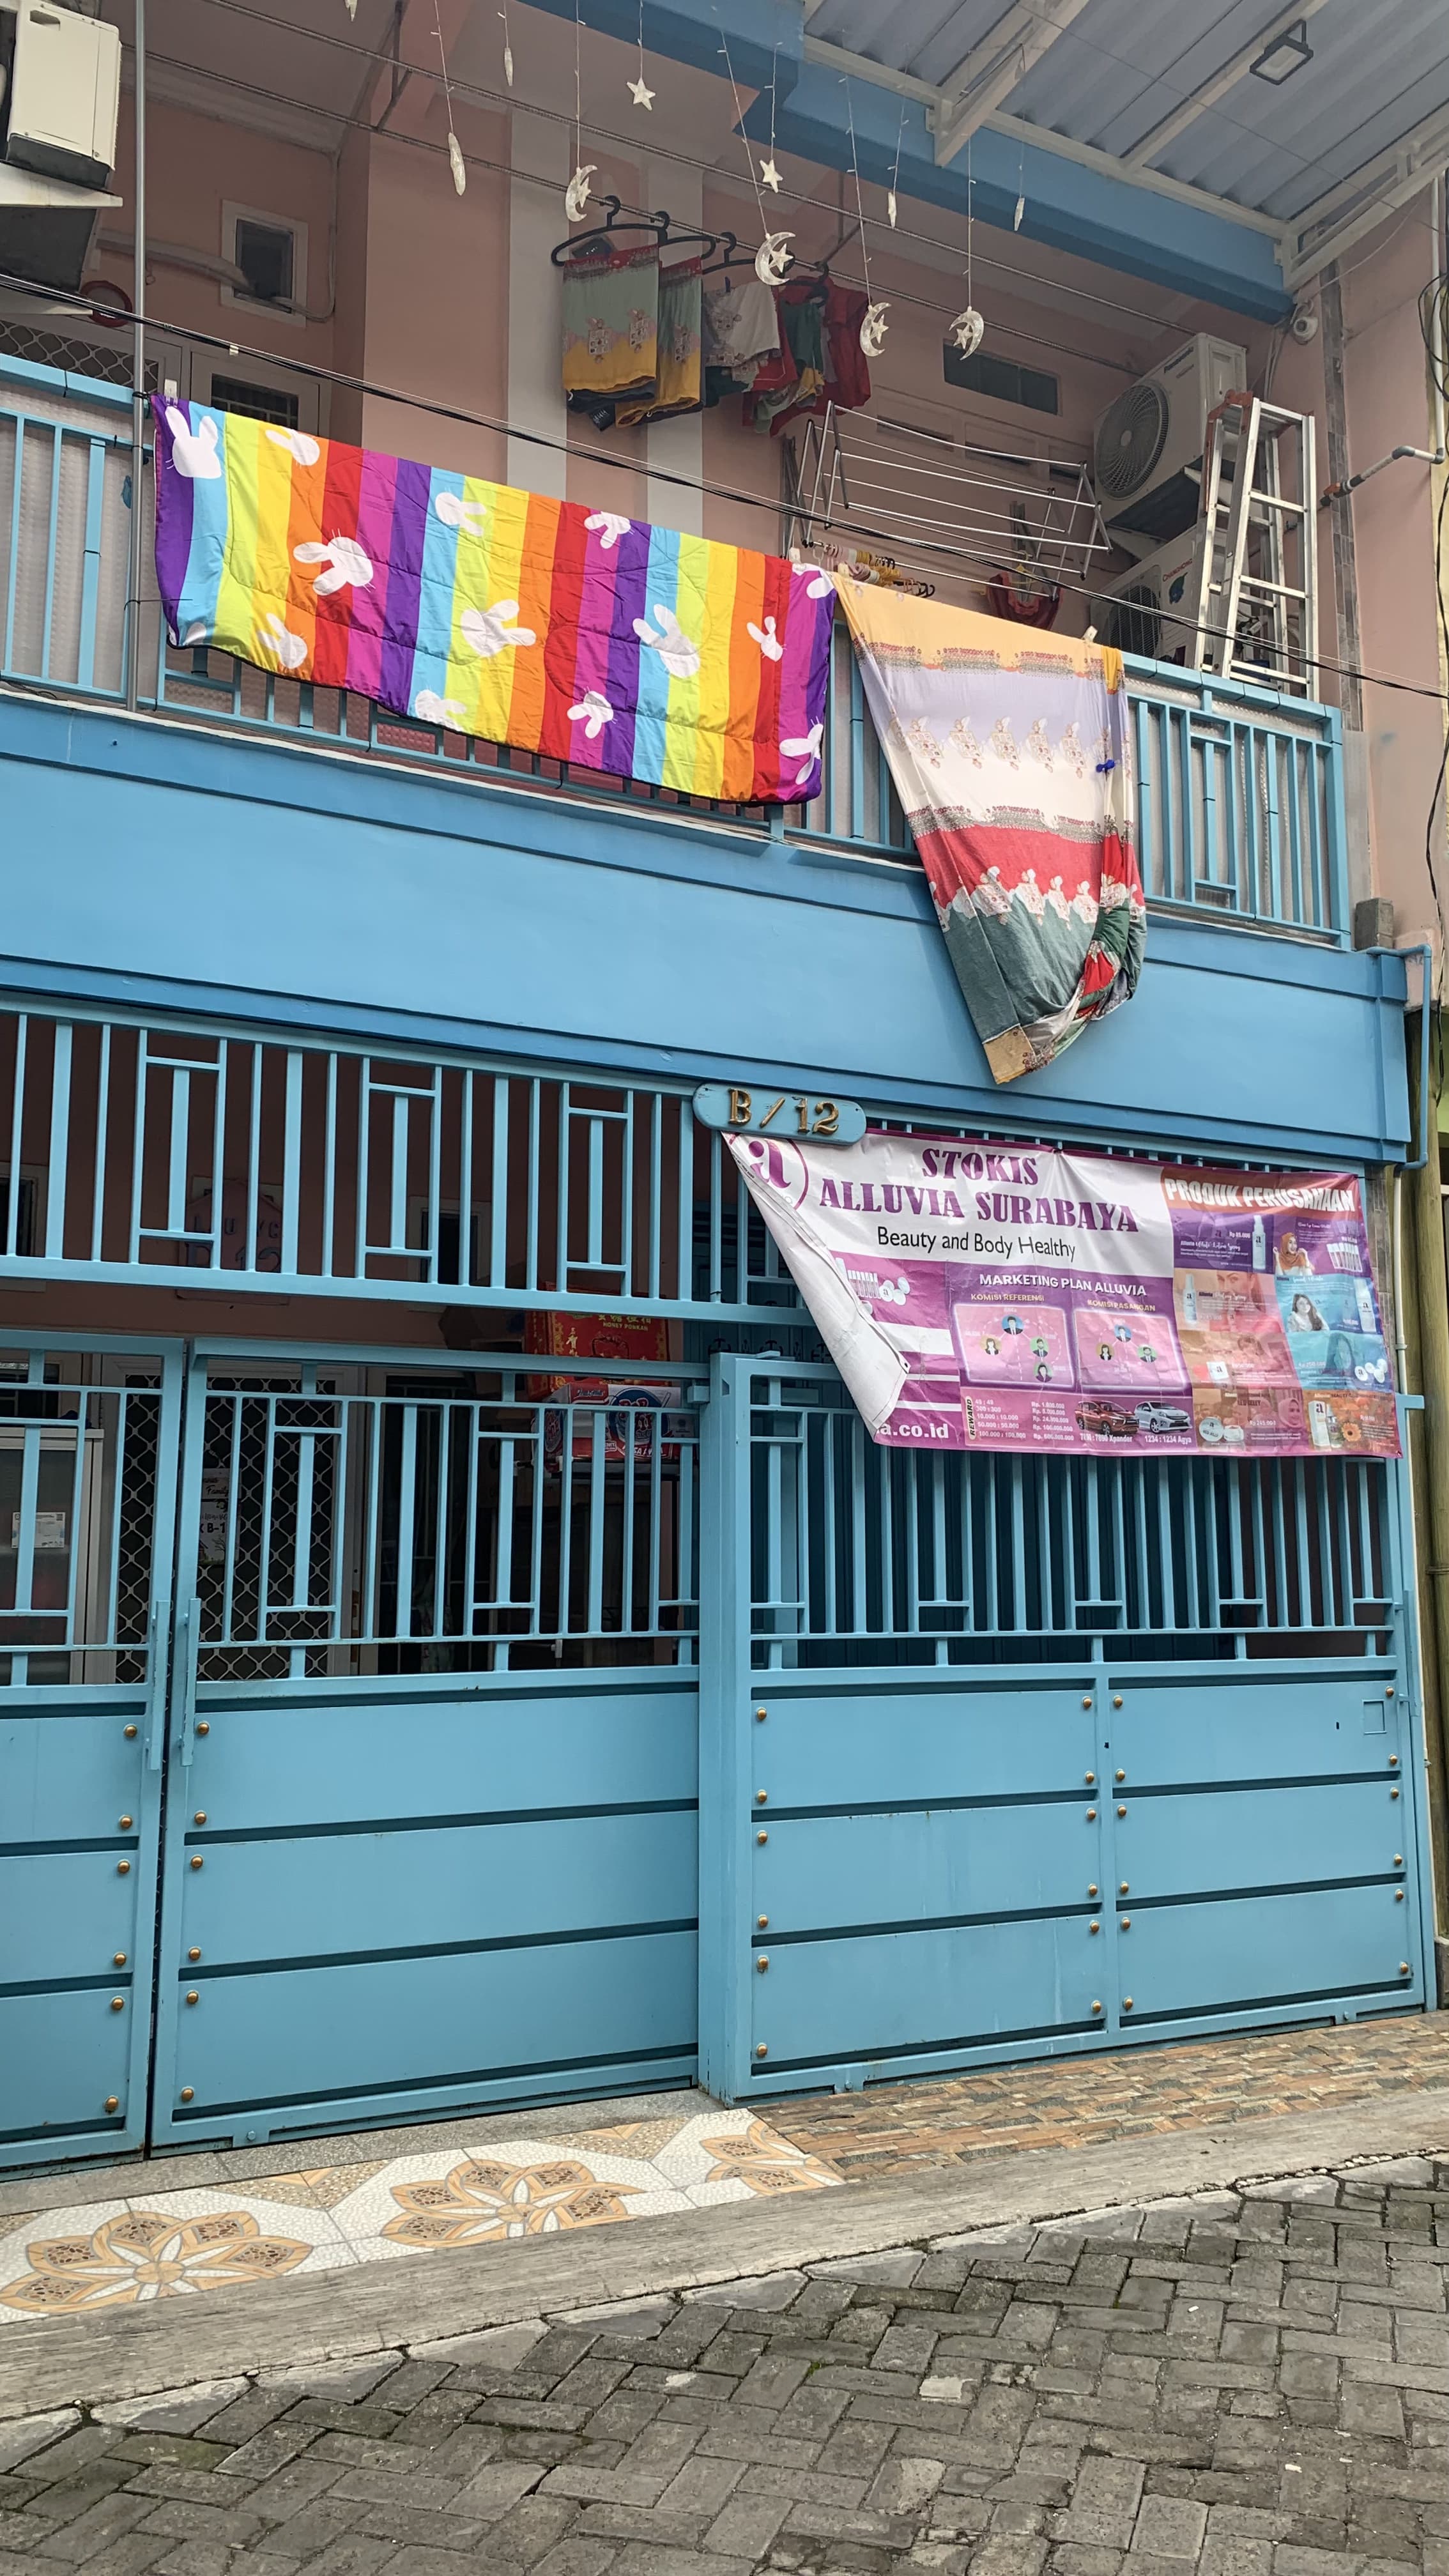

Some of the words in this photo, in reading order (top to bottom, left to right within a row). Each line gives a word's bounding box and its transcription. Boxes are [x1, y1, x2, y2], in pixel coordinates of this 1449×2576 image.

[921, 1148, 1038, 1186] STOKIS
[819, 1177, 965, 1218] ALLUVIA
[975, 1192, 1138, 1232] SURABAYA
[1164, 1177, 1243, 1207] PRODUK
[1241, 1186, 1355, 1212] PERUSAHAAN
[877, 1226, 937, 1254] Beauty
[942, 1232, 969, 1250] and
[974, 1233, 1013, 1259] Body
[1018, 1236, 1075, 1263] Healthy
[979, 1274, 1059, 1288] MARKETING
[1061, 1278, 1092, 1292] PLAN
[1094, 1282, 1147, 1296] ALLUVIA
[1003, 1294, 1045, 1302] REFERENSI
[1087, 1299, 1115, 1308] KOMISI
[1114, 1301, 1156, 1312] PASANGAN
[967, 1399, 976, 1436] REWARD
[878, 1423, 949, 1439] a.co.id
[1109, 1434, 1133, 1444] Xpander
[1177, 1436, 1192, 1445] Agya
